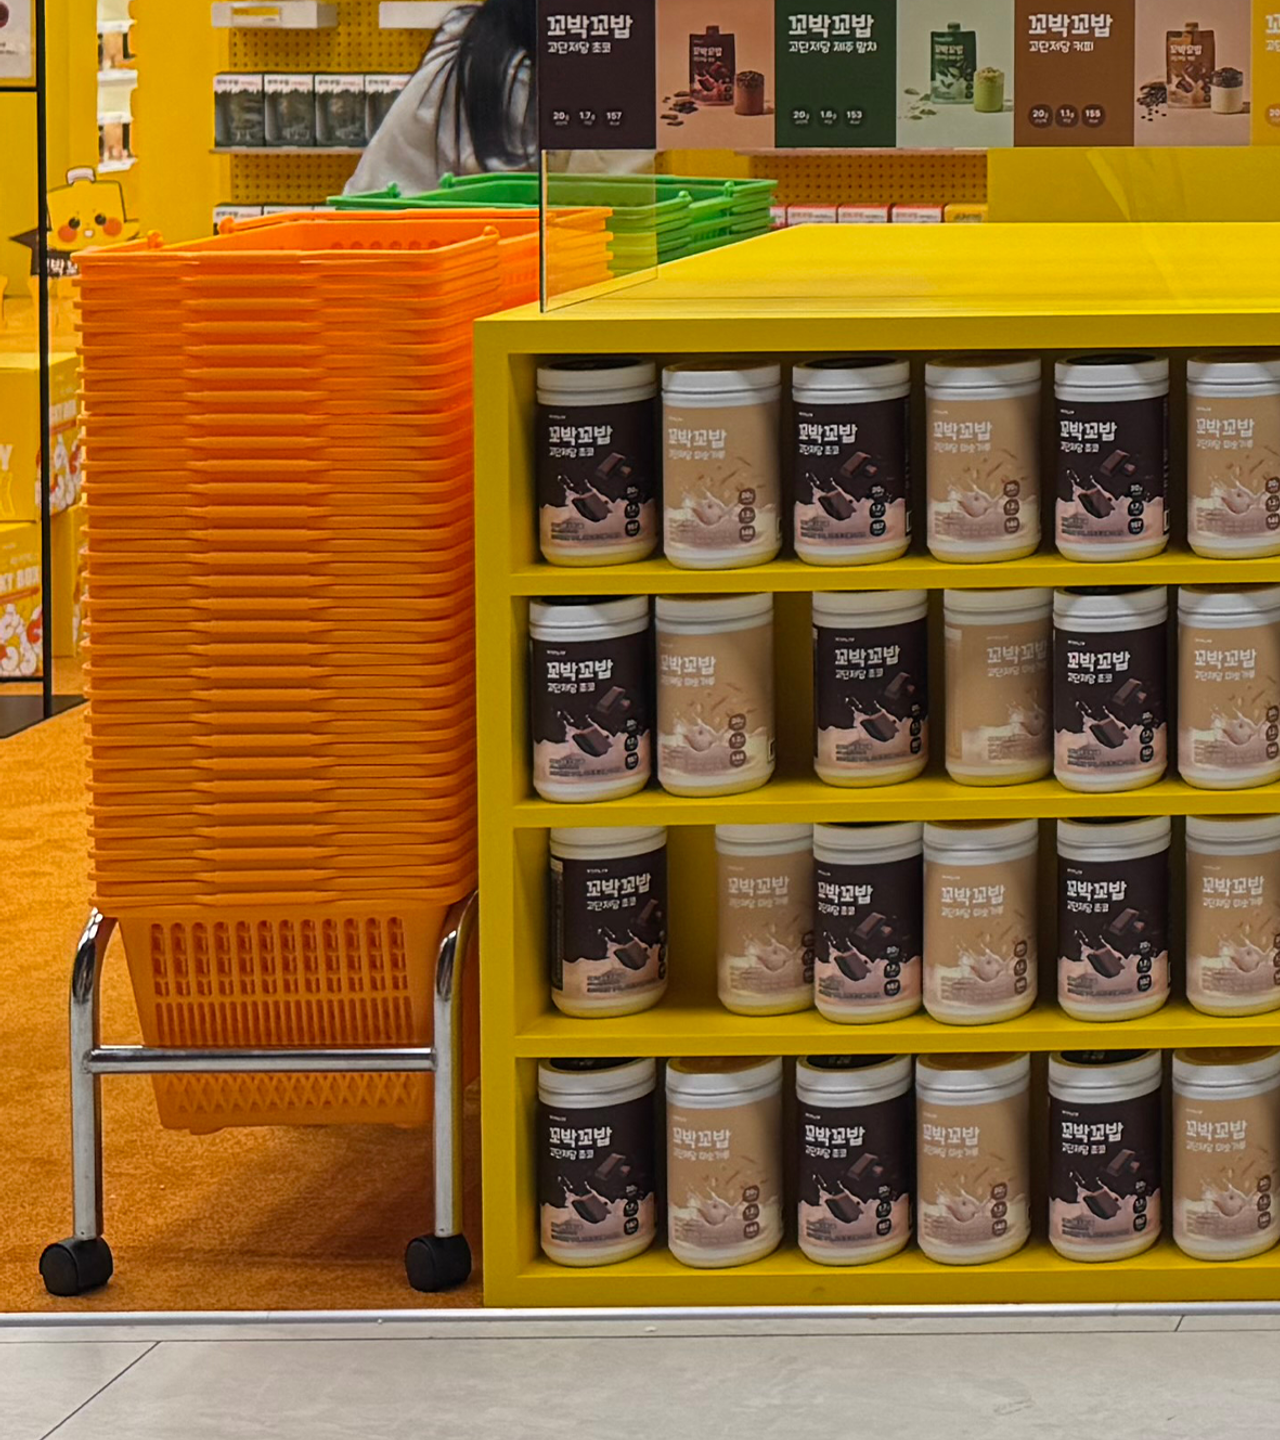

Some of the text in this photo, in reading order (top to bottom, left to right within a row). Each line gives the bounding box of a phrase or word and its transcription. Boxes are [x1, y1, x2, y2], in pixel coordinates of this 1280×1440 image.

[547, 15, 633, 40] 꼬박꼬밥
[788, 15, 874, 39] 꼬박꼬밥
[1028, 14, 1113, 38] 꼬박꼬밥
[547, 42, 611, 54] 고단저당 초코
[788, 42, 830, 54] 고단저당
[833, 42, 854, 53] 제주
[1029, 41, 1094, 53] 고단저당 커피
[549, 425, 613, 446] 꼬박꼬밥
[798, 423, 858, 444] 꼬박꼬밥
[1060, 420, 1117, 441] 꼬박꼬밥
[835, 645, 900, 667] 꼬박꼬밥
[1067, 651, 1131, 672] 꼬박꼬밥
[546, 659, 613, 682] 꼬박꼬밥
[586, 873, 651, 898] 꼬박꼬밥
[818, 882, 873, 905] 꼬박꼬밥
[1067, 880, 1127, 902] 꼬박꼬밥
[549, 1126, 612, 1148] 꼬박꼬밥
[805, 1125, 866, 1147] 꼬박꼬밥
[1061, 1122, 1124, 1143] 꼬박꼬밥
